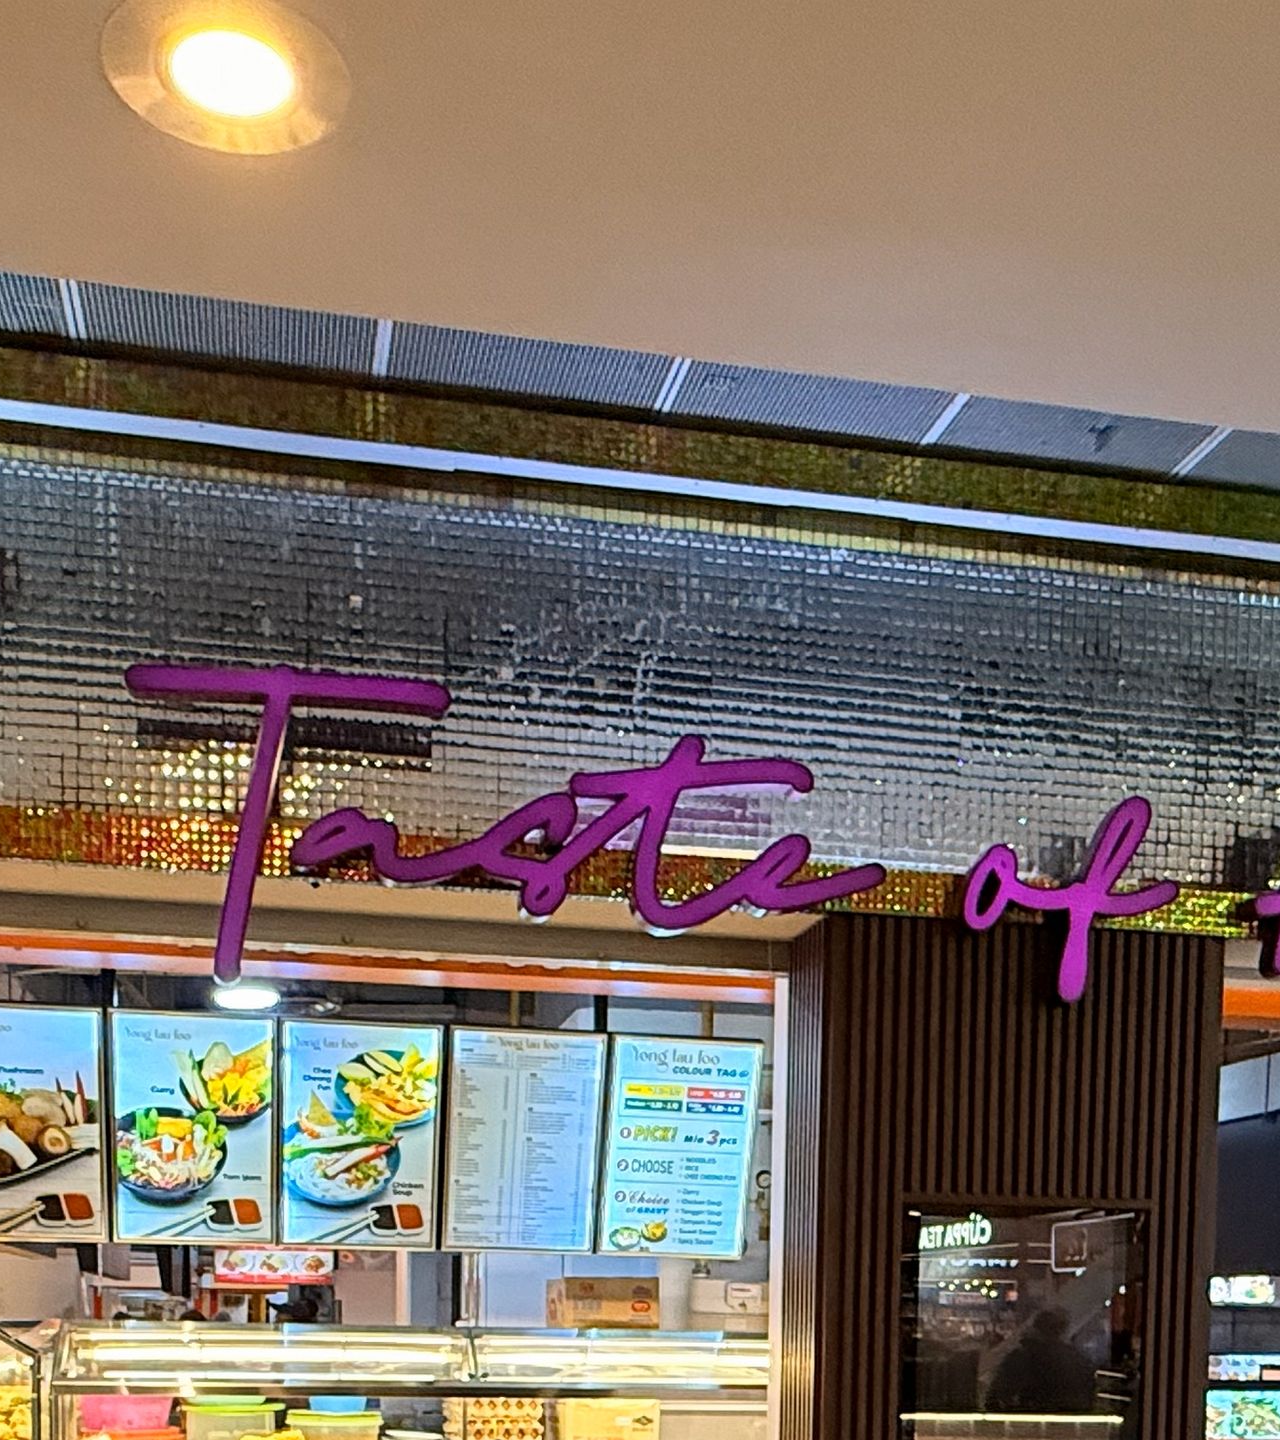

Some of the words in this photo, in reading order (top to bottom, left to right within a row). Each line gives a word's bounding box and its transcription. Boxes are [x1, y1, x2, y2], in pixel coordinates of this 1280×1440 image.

[126, 664, 886, 982] Taste
[960, 797, 1179, 1003] of
[672, 1066, 713, 1076] COLOUR
[716, 1068, 737, 1078] TAG
[706, 1130, 720, 1145] 3
[631, 1159, 674, 1174] CHOOSE
